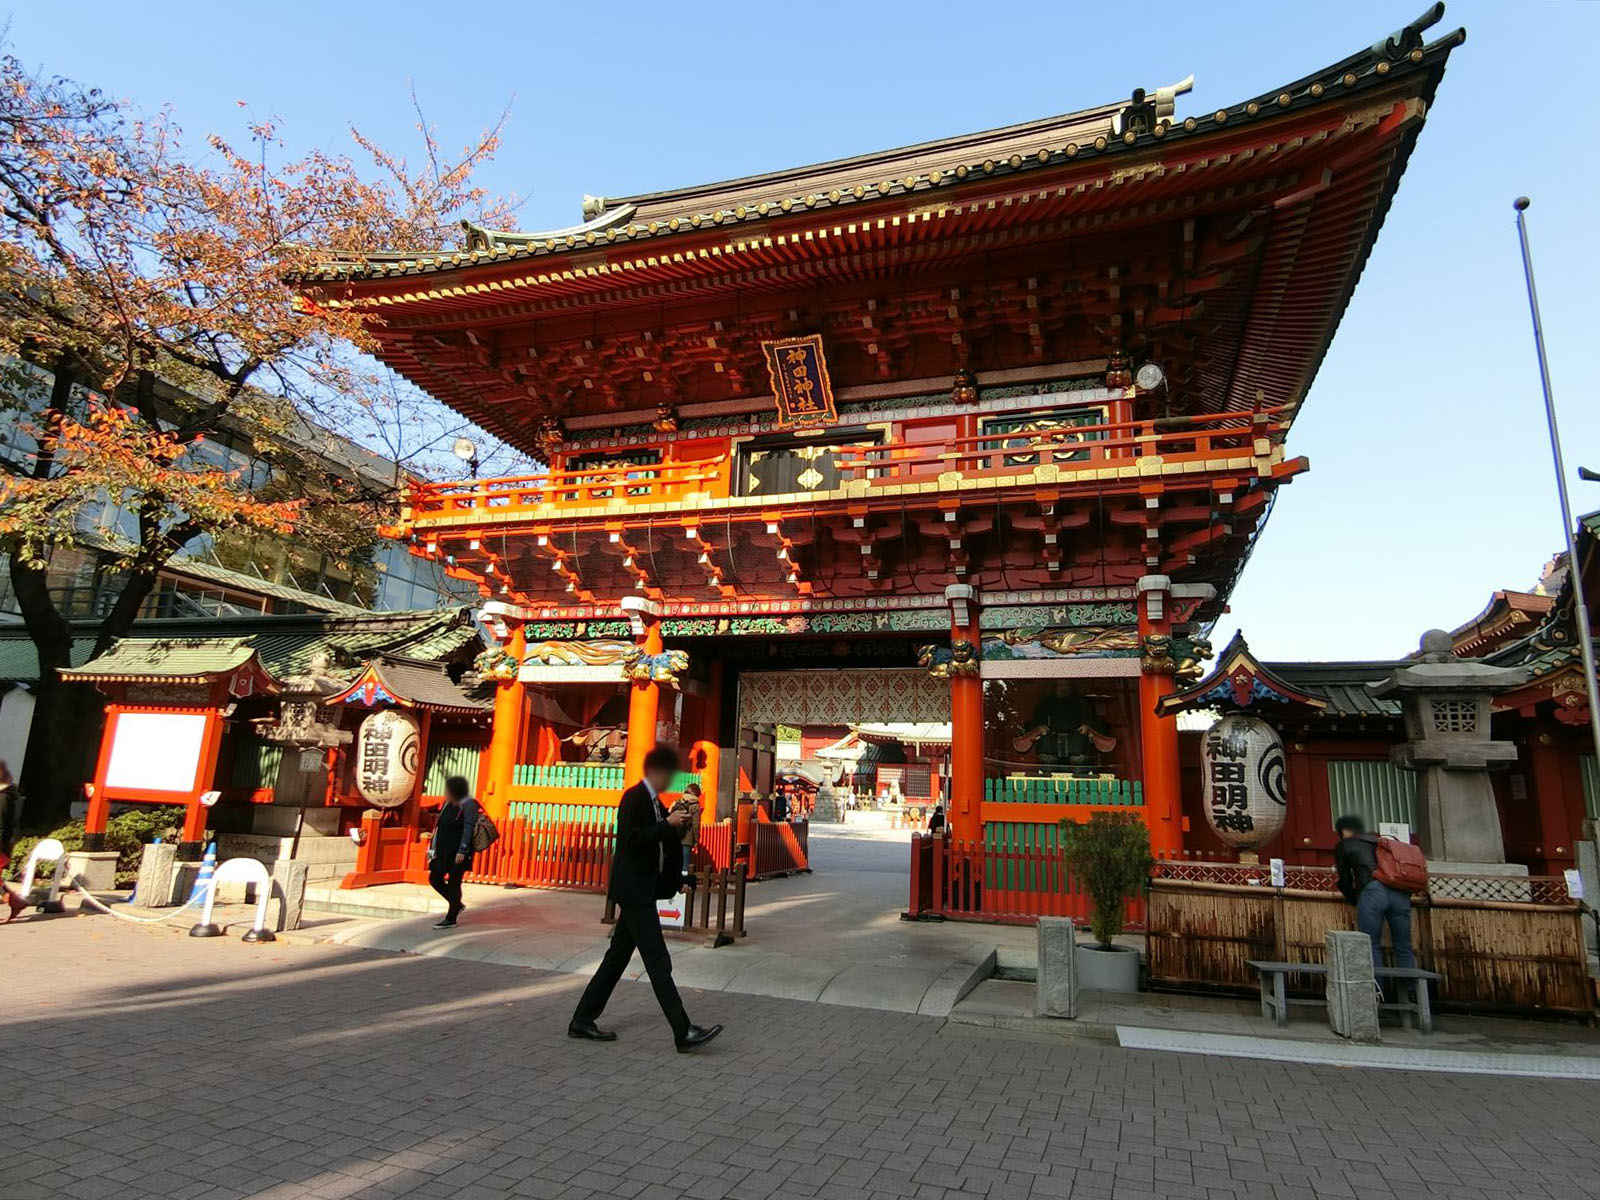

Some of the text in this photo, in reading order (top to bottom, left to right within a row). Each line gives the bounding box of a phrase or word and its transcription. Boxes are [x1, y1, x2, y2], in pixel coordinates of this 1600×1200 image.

[786, 348, 819, 411] 神田神社
[363, 723, 393, 794] 神田明神
[1206, 734, 1254, 833] 神田明神
